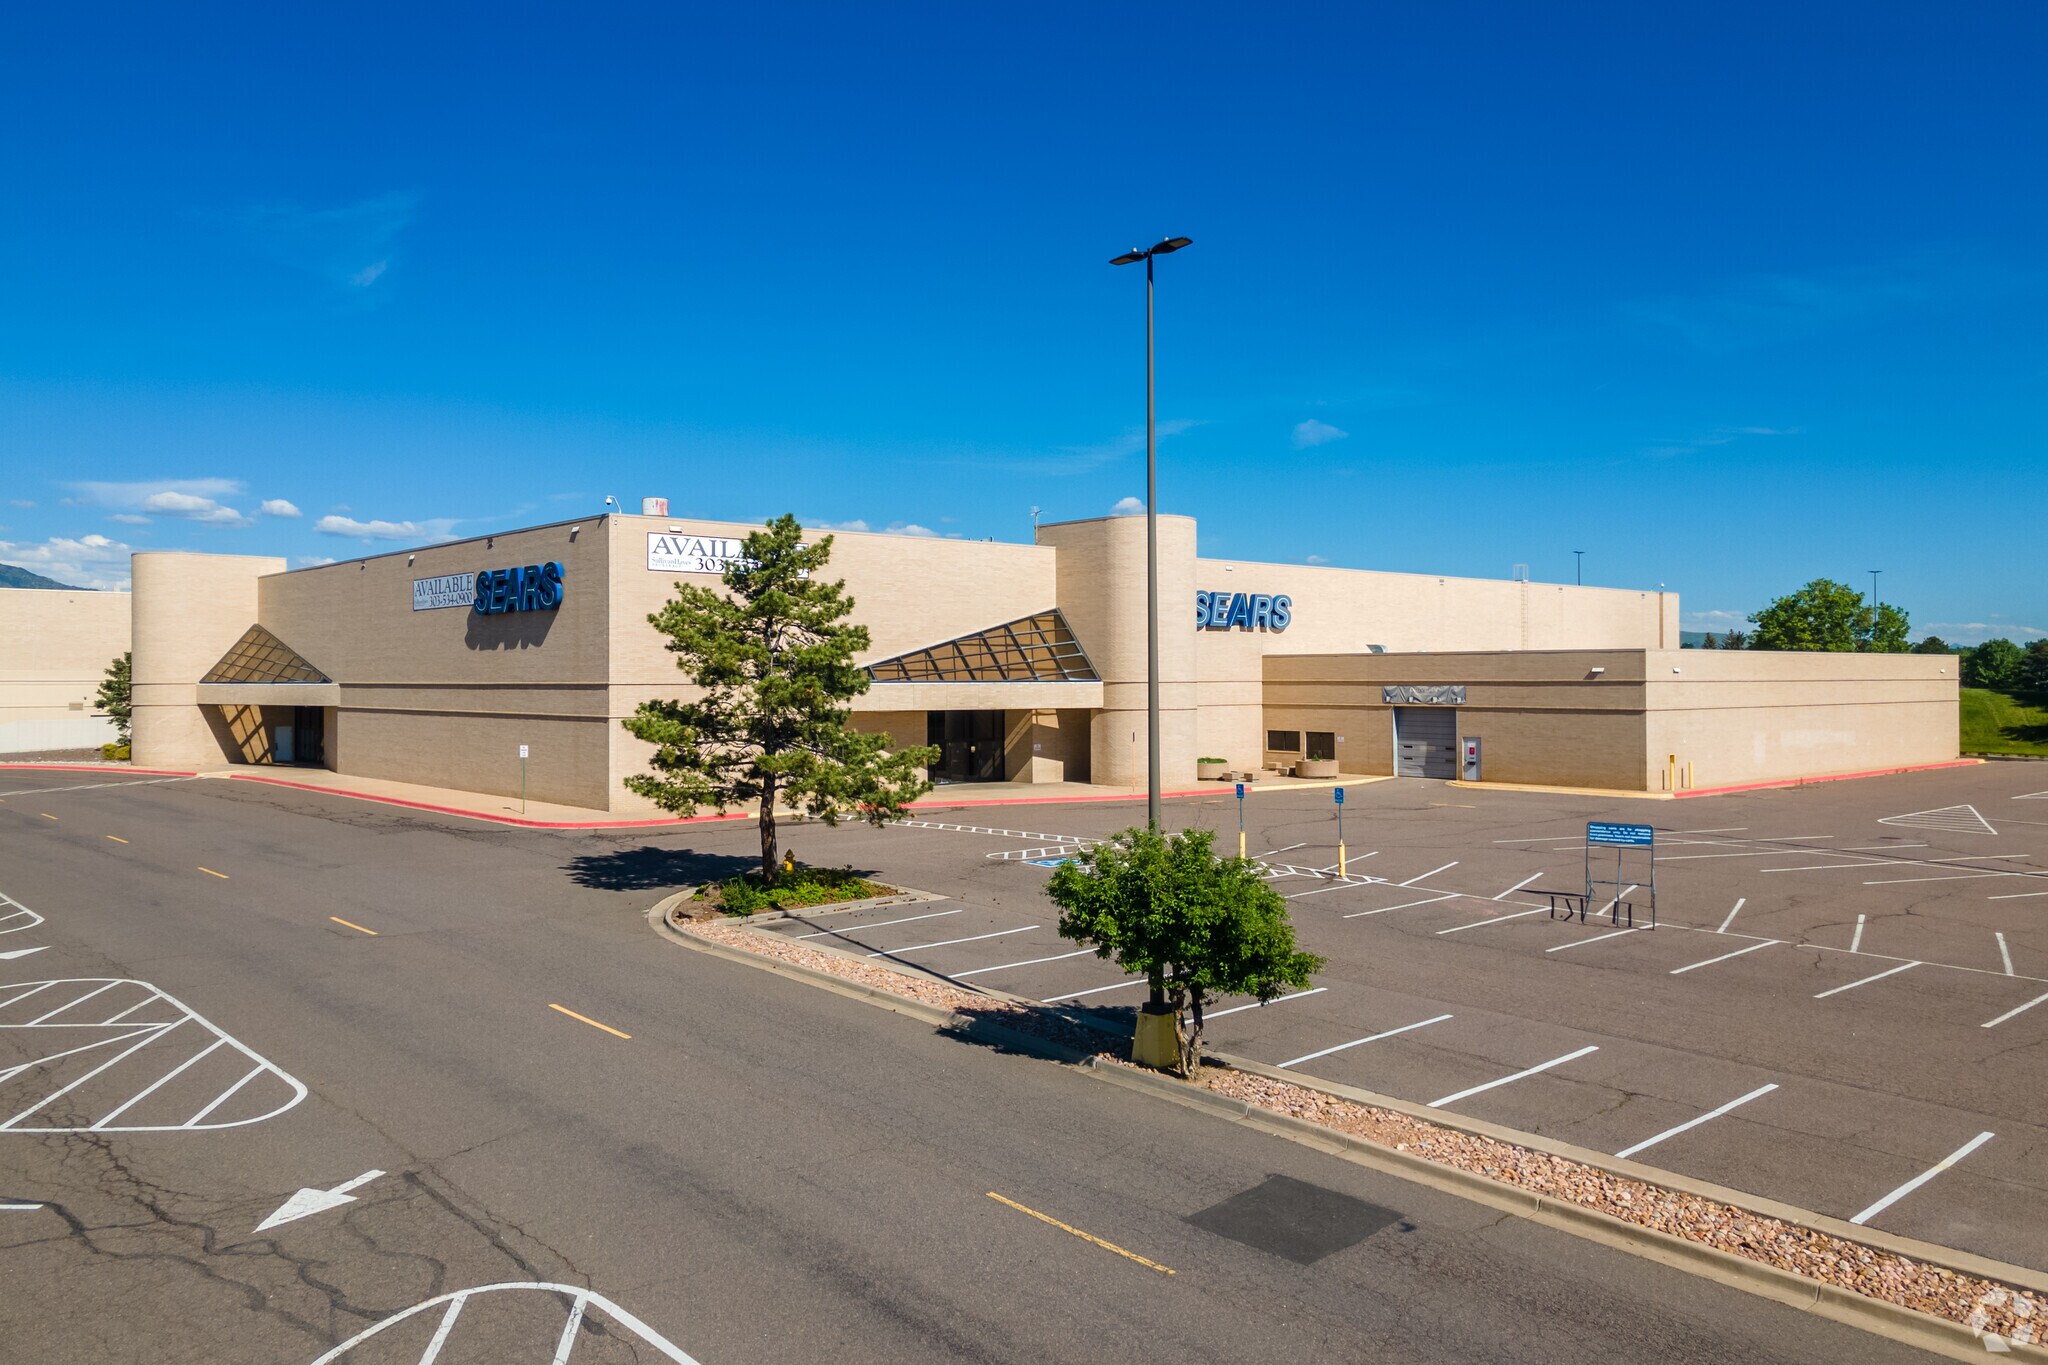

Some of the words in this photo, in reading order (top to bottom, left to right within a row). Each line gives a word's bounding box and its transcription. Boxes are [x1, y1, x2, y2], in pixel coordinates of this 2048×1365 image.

[414, 574, 473, 597] AVAILABLE
[474, 561, 565, 616] SEARS
[1196, 590, 1293, 630] SEARS
